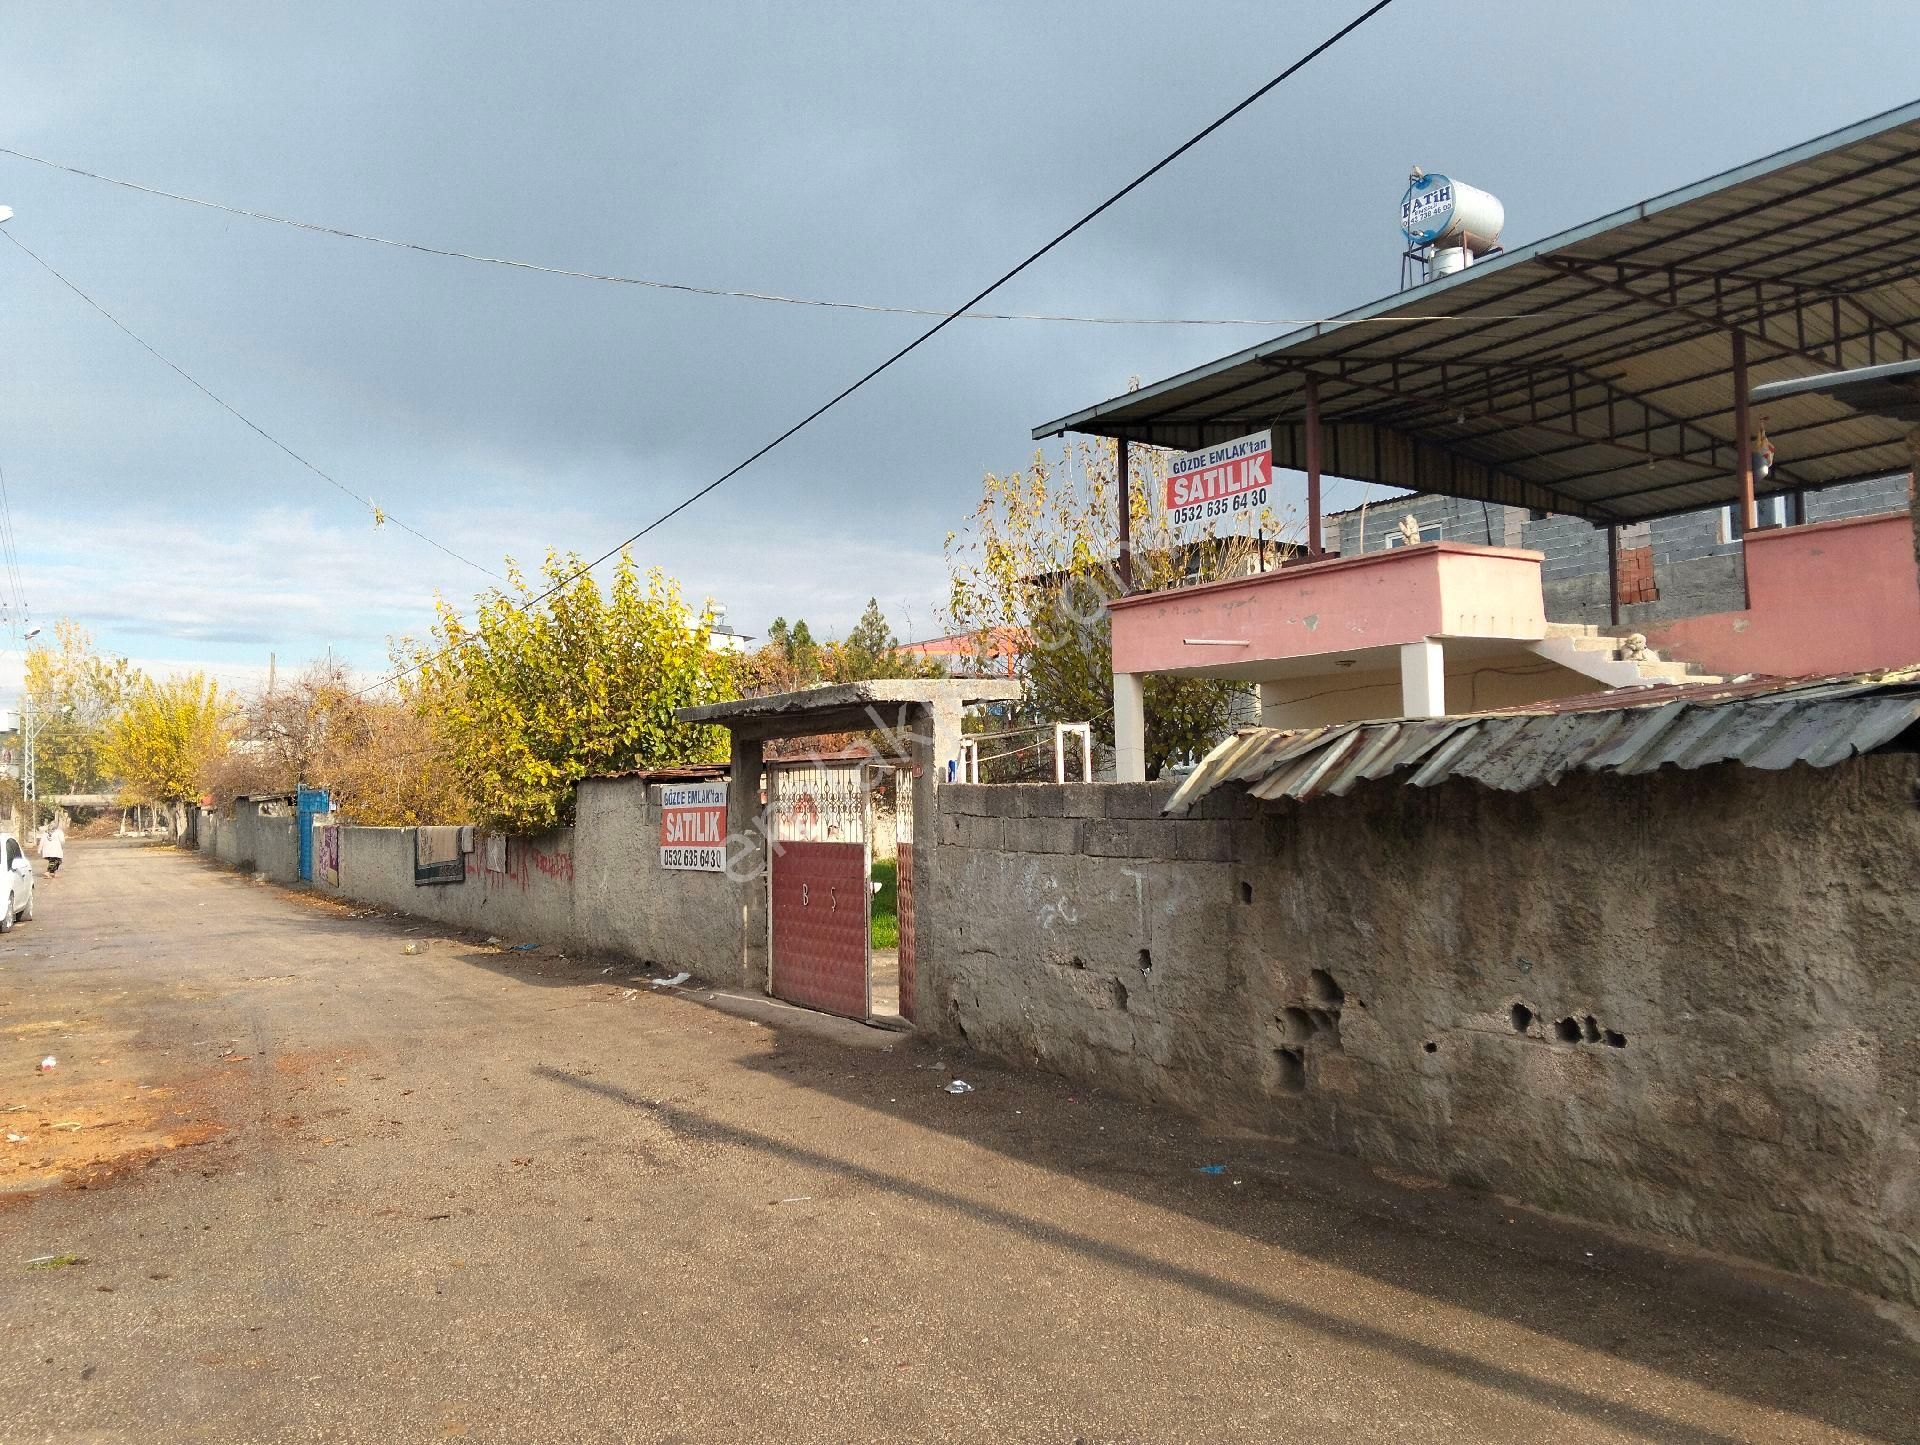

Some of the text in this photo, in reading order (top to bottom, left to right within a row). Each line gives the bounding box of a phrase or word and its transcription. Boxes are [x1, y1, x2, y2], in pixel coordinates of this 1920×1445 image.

[1173, 439, 1267, 474] GÖZDE EMLAK'tan
[1174, 456, 1267, 505] SATILIK
[1174, 488, 1267, 525] 0532 635 64 30
[664, 788, 686, 806] GÖZDE
[666, 811, 721, 842] SATILIK
[664, 849, 682, 867] 0532
[683, 849, 698, 867] 635
